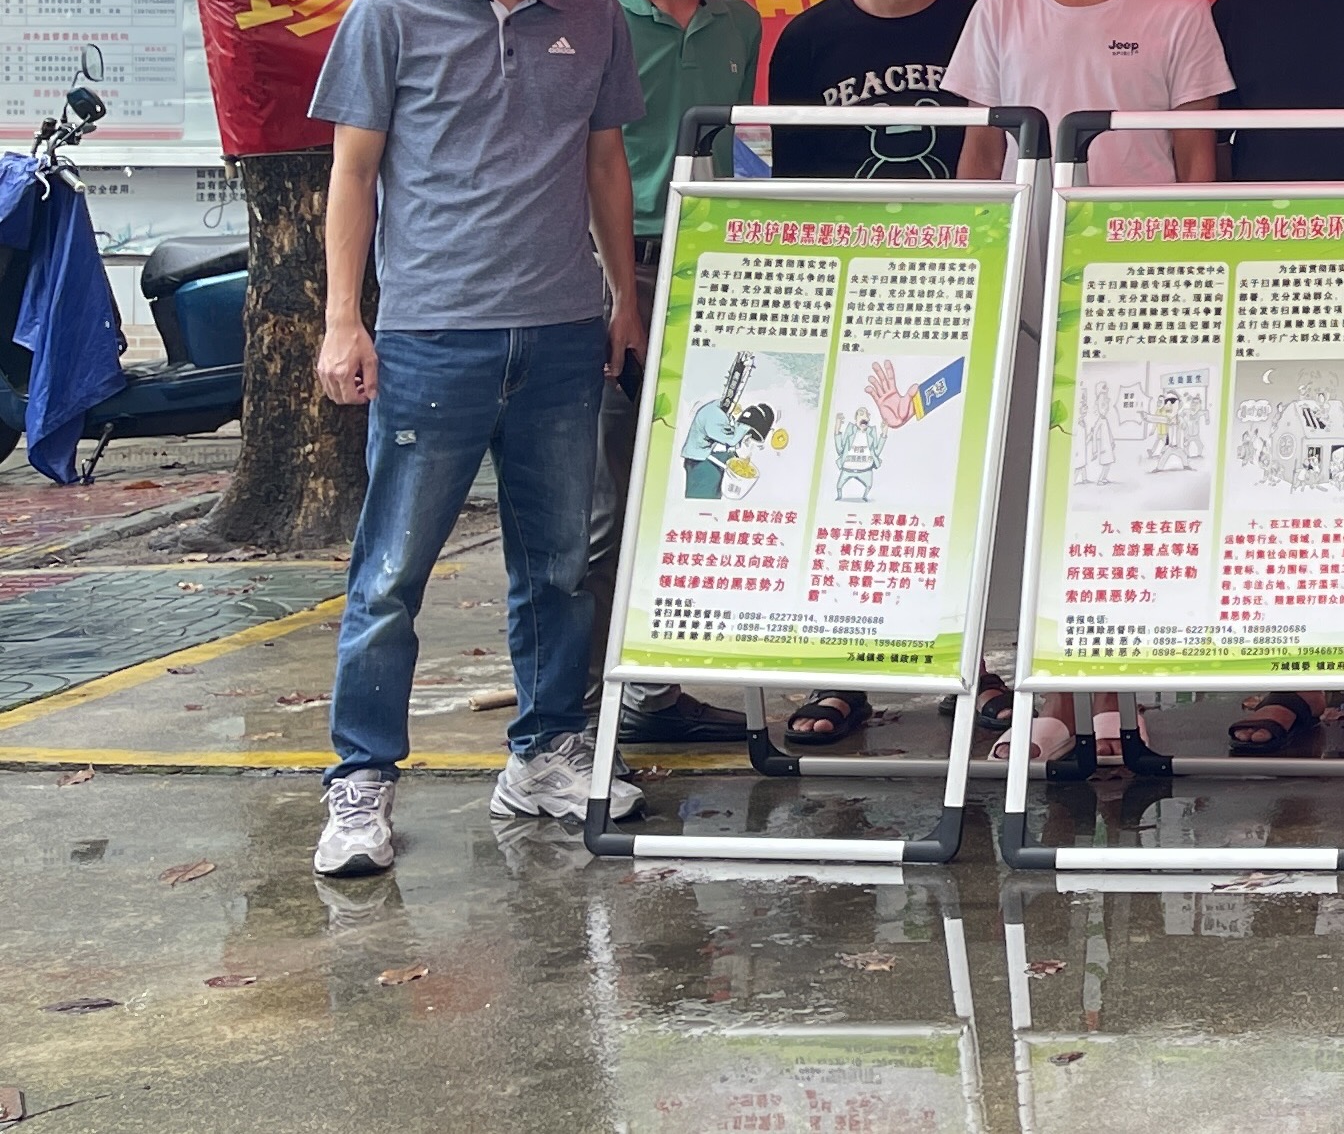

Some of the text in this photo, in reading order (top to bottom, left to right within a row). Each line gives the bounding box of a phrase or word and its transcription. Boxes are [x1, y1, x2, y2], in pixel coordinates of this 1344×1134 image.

[1108, 39, 1140, 53] Jeep
[726, 219, 971, 248] 坚决铲除黑恶势力净化治安环境
[698, 509, 798, 525] 一、威胁政治安
[1101, 519, 1203, 534] 九、寄生在医疗
[665, 529, 786, 548] 全特别是制度安全、
[815, 527, 931, 544] 胁等手段把持基层政
[1068, 542, 1199, 558] 机构、旅游景点等场
[662, 551, 790, 571] 政权安全以及向政治
[658, 574, 786, 593] 领域渗透的黑恶势力
